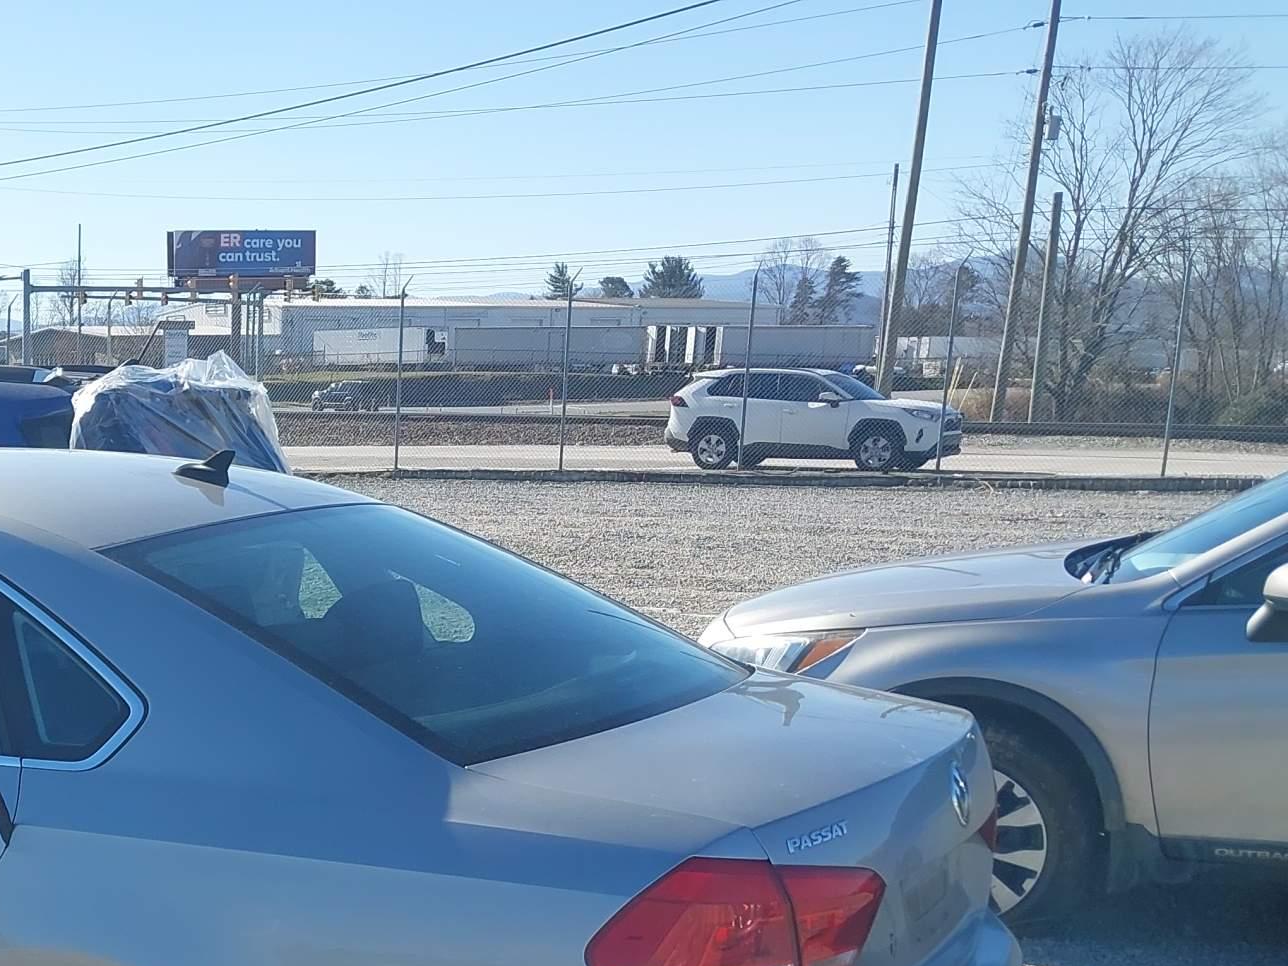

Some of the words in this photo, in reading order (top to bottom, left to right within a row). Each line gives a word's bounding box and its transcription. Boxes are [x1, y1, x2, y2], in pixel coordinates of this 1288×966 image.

[220, 233, 241, 247] ER
[244, 238, 273, 248] care
[277, 238, 301, 251] you
[219, 251, 243, 262] can
[246, 250, 280, 262] trust.
[786, 820, 849, 854] PASSAT
